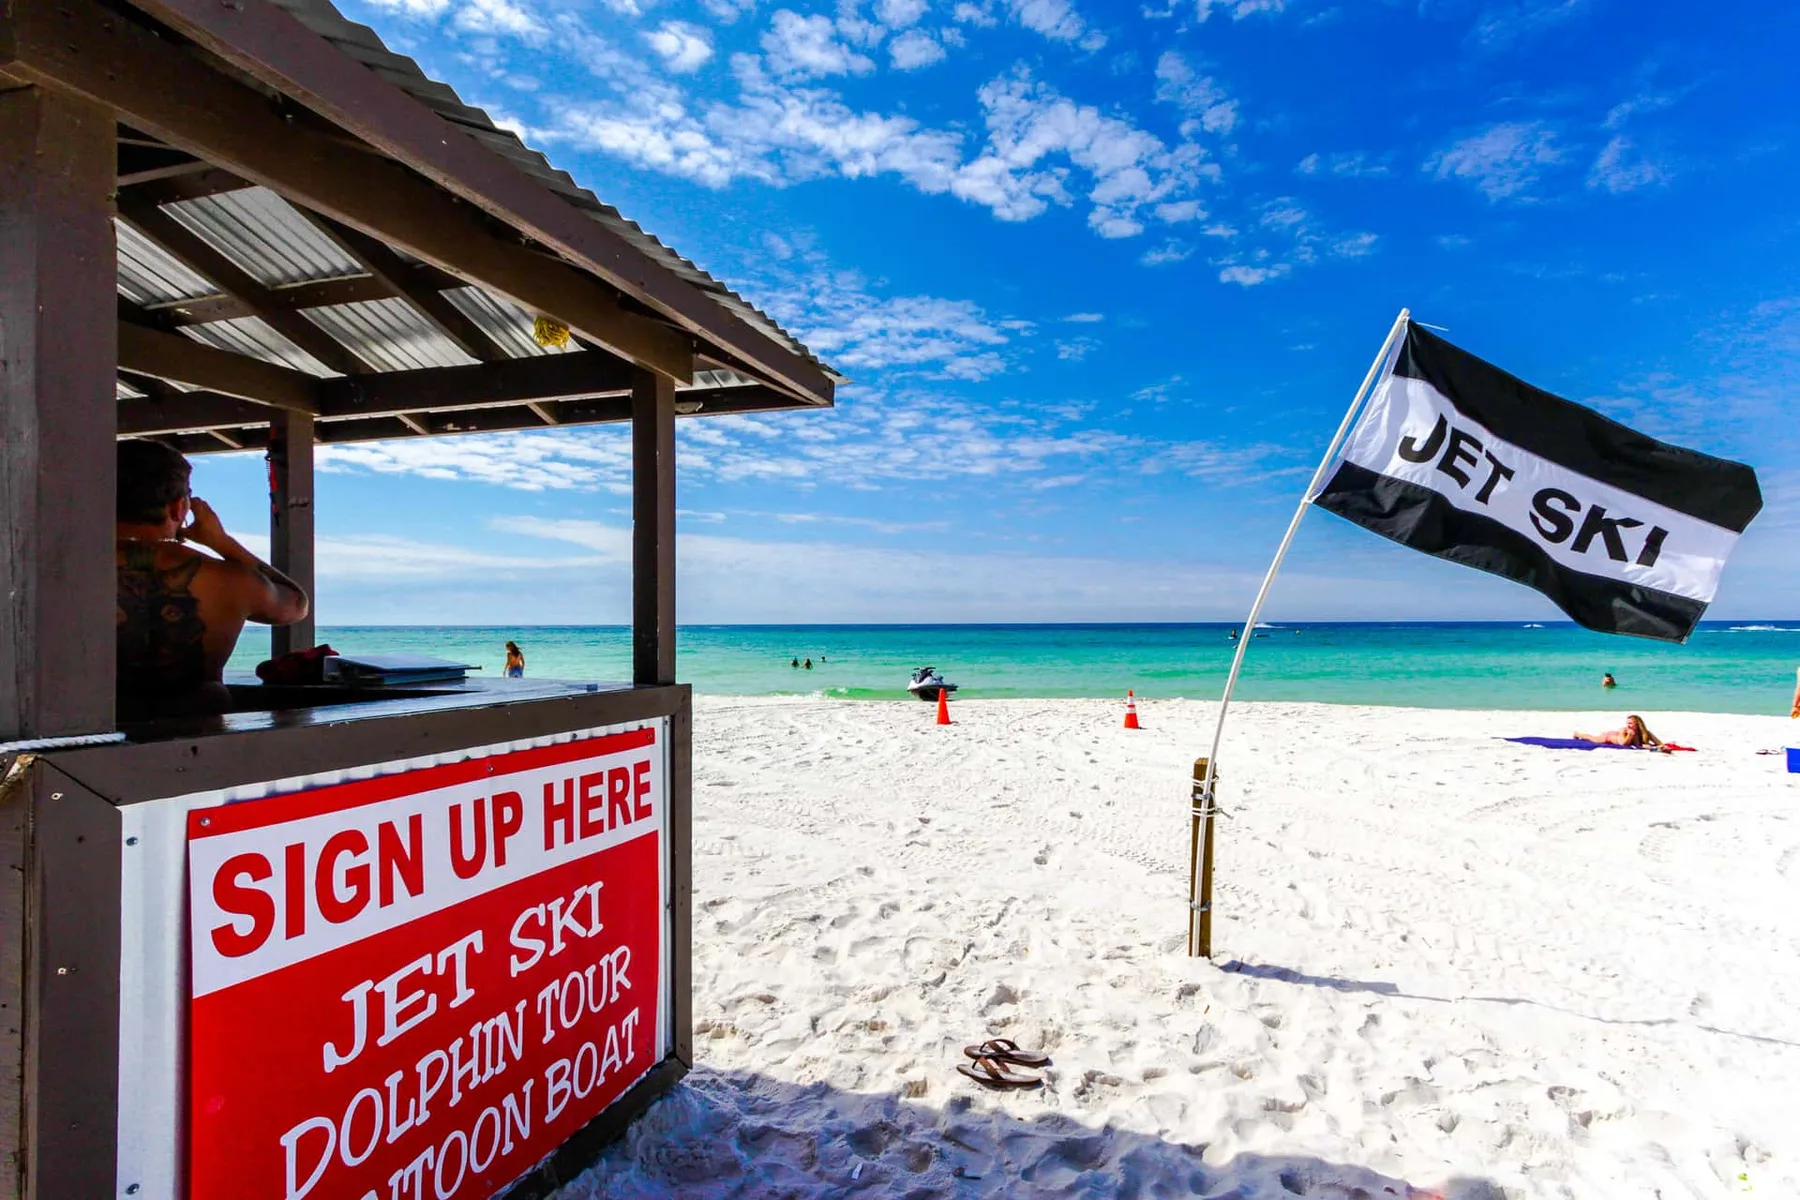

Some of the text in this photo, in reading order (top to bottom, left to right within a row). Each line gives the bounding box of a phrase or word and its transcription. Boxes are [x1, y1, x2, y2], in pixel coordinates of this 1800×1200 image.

[1398, 412, 1669, 567] JET SKI
[210, 759, 653, 958] SIGN UP HERE
[279, 945, 632, 1200] DOLPHIN TOUR
[323, 881, 604, 1074] JET SKI
[544, 1006, 639, 1124] BOAT
